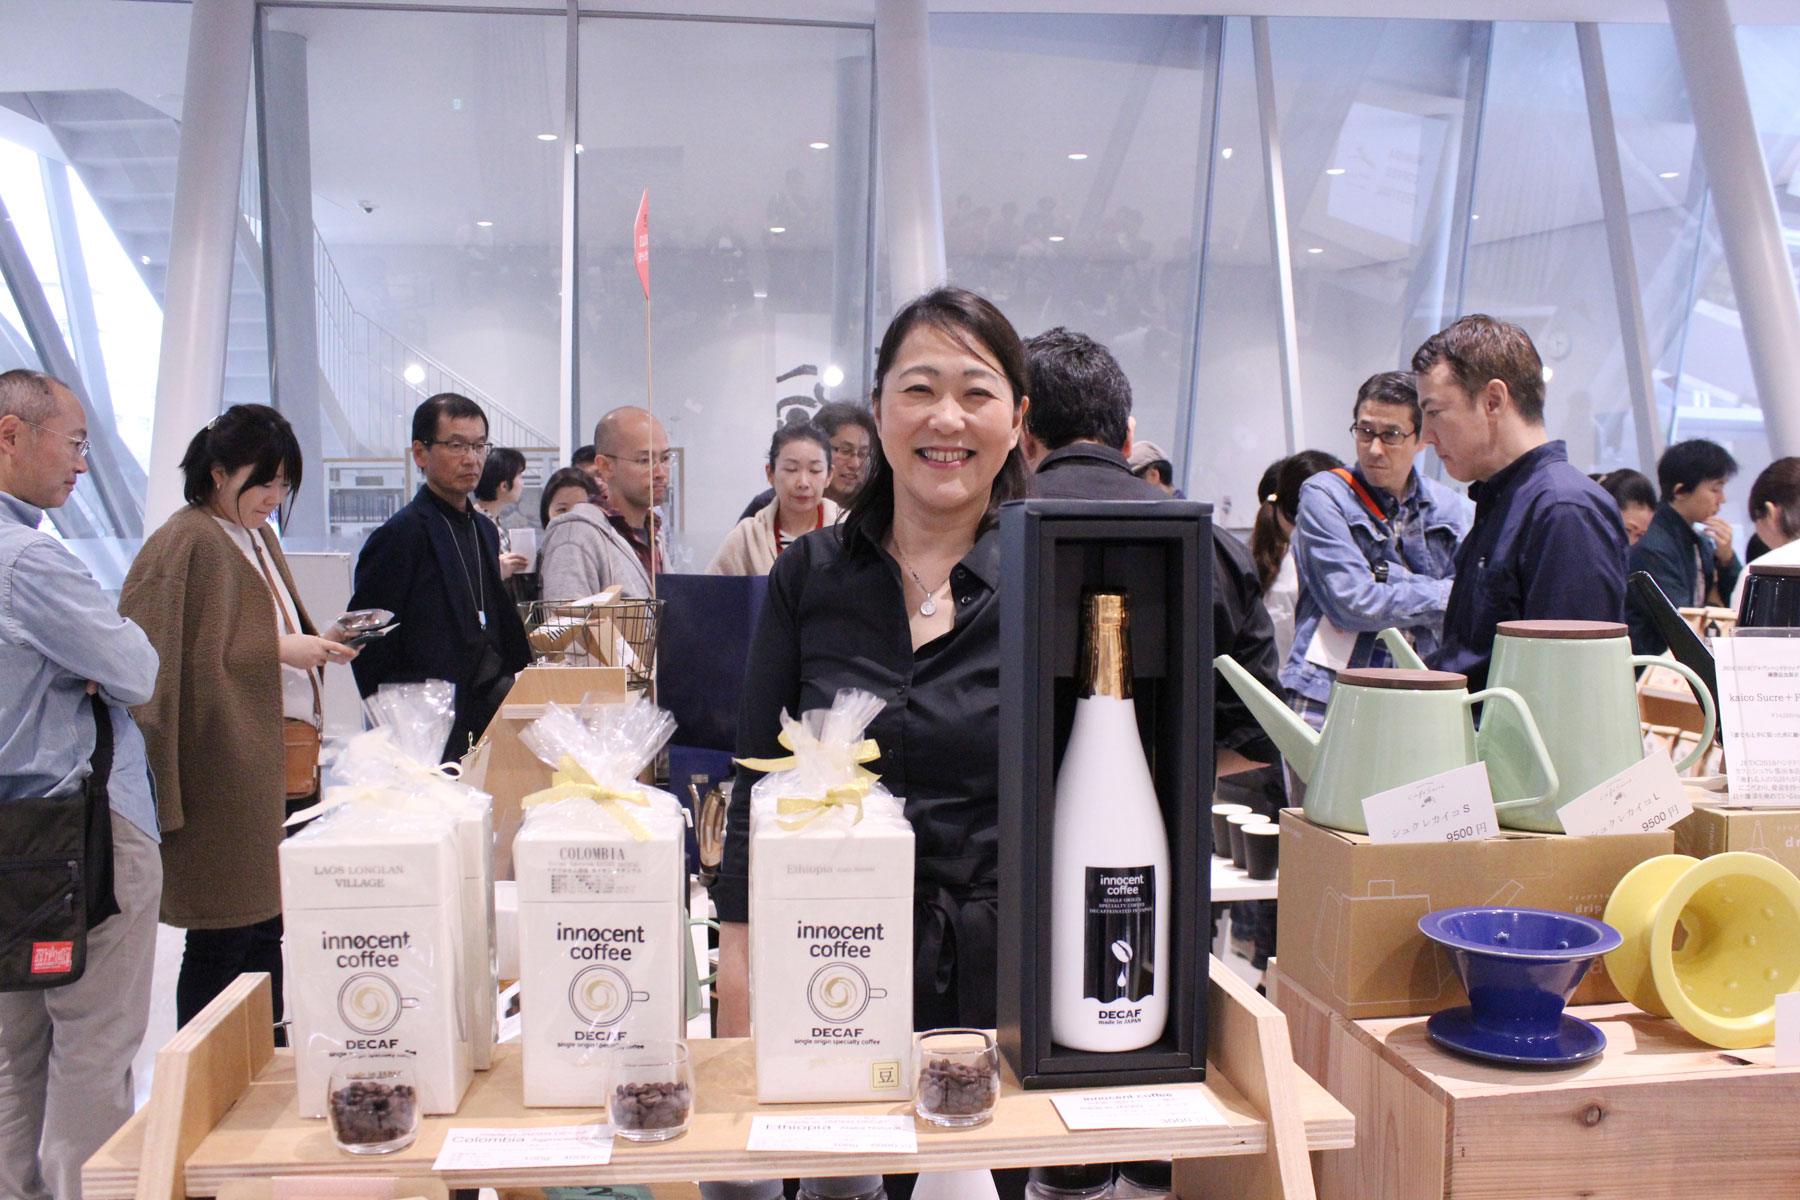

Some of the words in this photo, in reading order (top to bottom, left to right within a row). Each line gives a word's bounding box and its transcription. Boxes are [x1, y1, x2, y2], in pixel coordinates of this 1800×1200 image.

[560, 847, 625, 860] COLOMBIA
[314, 865, 345, 875] LAOS
[786, 864, 834, 876] Ethiopia
[335, 878, 385, 888] VILLAGE
[1100, 873, 1145, 885] innocent
[1107, 885, 1139, 895] coffee
[570, 943, 632, 961] coffee
[809, 940, 871, 958] coffee
[336, 950, 399, 968] coffee
[1098, 1008, 1142, 1019] DECAF
[812, 1027, 864, 1038] DECAF
[346, 1039, 399, 1050] DECAF
[451, 1135, 526, 1144] Colombia
